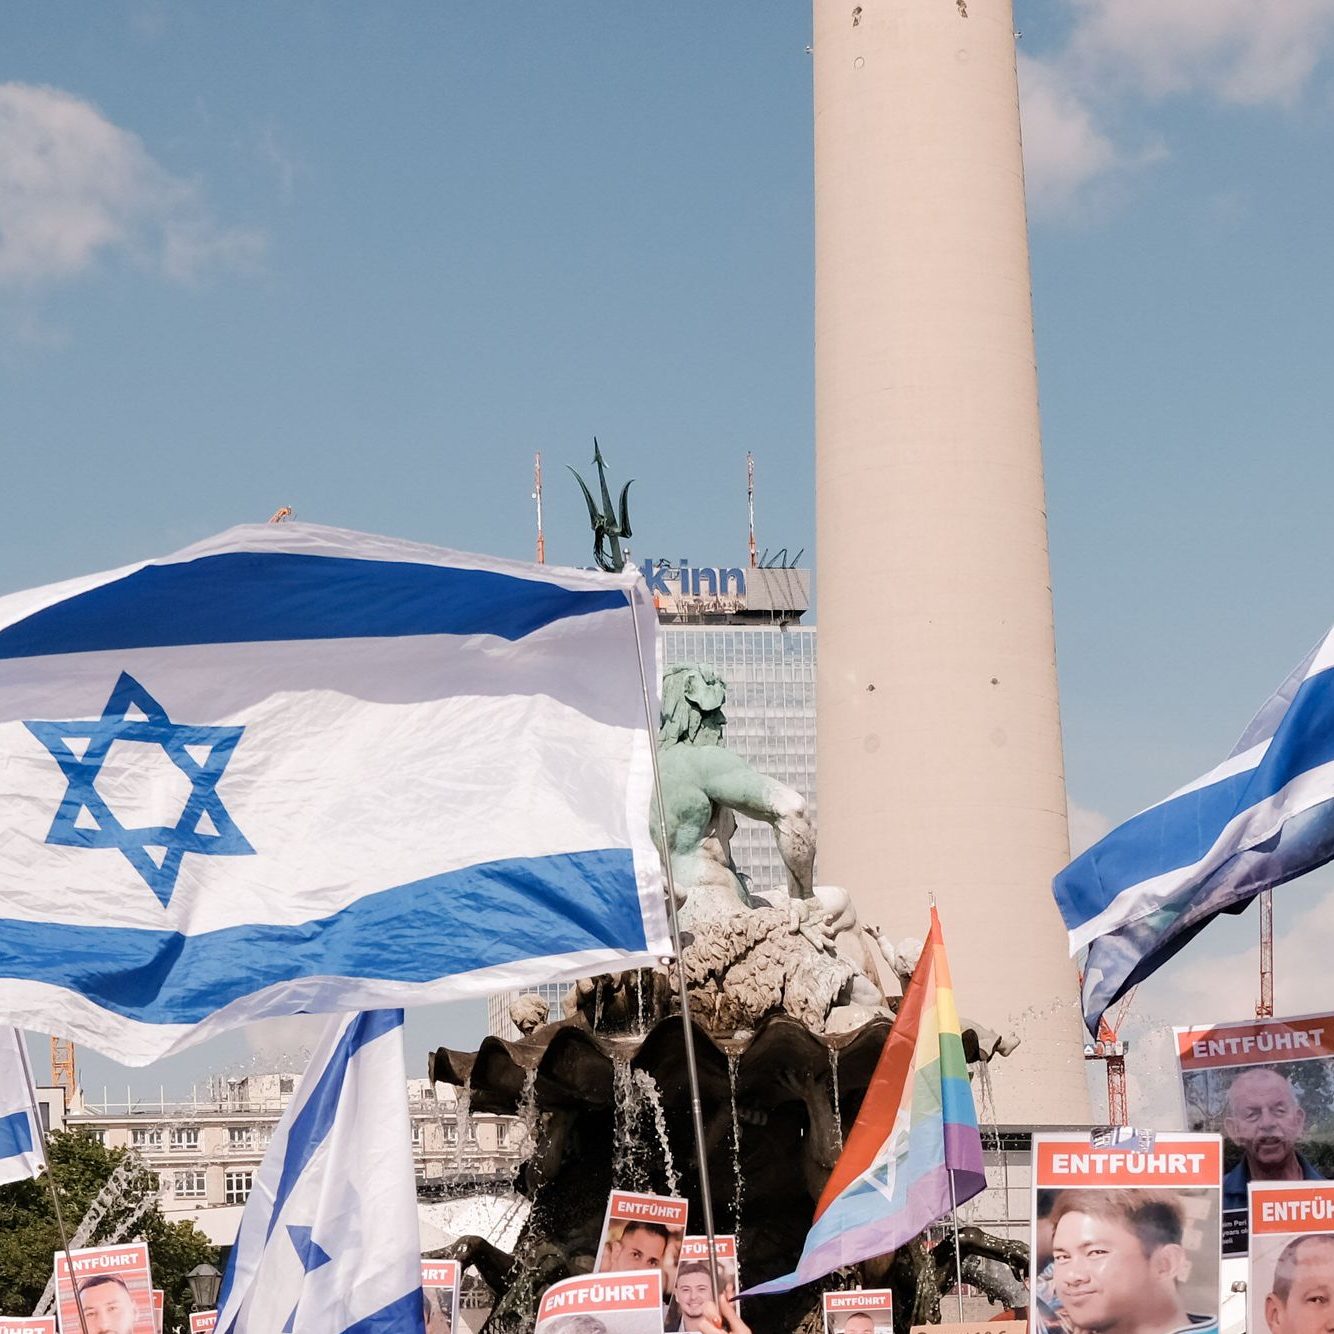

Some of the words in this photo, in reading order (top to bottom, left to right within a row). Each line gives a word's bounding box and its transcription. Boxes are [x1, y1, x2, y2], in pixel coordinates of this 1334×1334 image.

[1192, 1028, 1325, 1058] ENTFÜHRT
[1052, 1151, 1205, 1174] ENTFÜHRT
[617, 1201, 682, 1219] ENTFÜHRT
[544, 1282, 649, 1312] ENTFÜHRT
[831, 1296, 886, 1307] ENTFÜHRT
